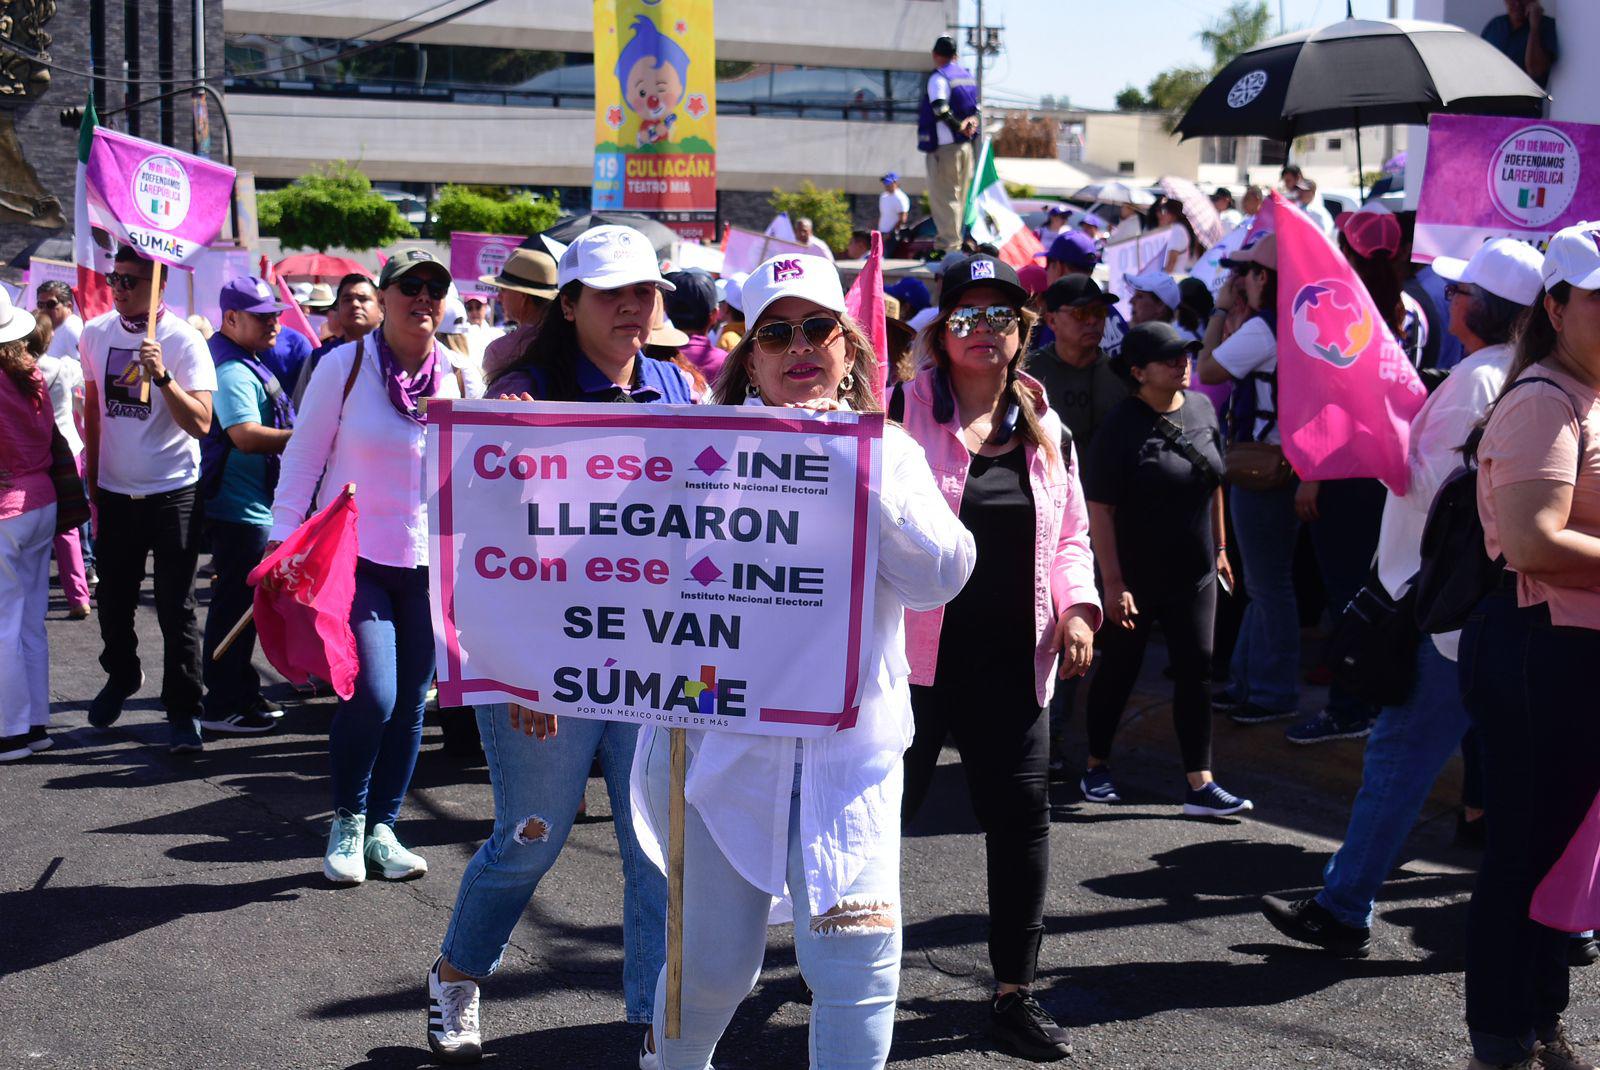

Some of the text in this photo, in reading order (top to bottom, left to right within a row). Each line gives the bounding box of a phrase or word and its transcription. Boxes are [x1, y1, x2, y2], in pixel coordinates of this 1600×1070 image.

[1515, 139, 1564, 153] 19 DE MAYO
[598, 157, 618, 178] 19
[626, 155, 715, 177] CULIACÁN.
[1504, 155, 1564, 168] #DEFENDAMOS
[141, 172, 181, 190] #DEFENDAMOS
[1502, 167, 1563, 184] LAREPÚBLICA
[628, 180, 690, 193] TEATRO MIA
[473, 444, 830, 483] Con ese INE
[685, 481, 828, 495] Instituto Nacional Electoral
[528, 502, 799, 545] LLEGARON
[474, 547, 825, 595] Con ese INE
[681, 591, 823, 608] Instituto Nacional Electoral
[563, 606, 741, 650] SE VAN
[577, 706, 596, 714] POR
[617, 708, 653, 719] MÉXICO
[655, 714, 675, 722] QUE
[693, 717, 705, 725] DE
[708, 717, 729, 727] MÁS
